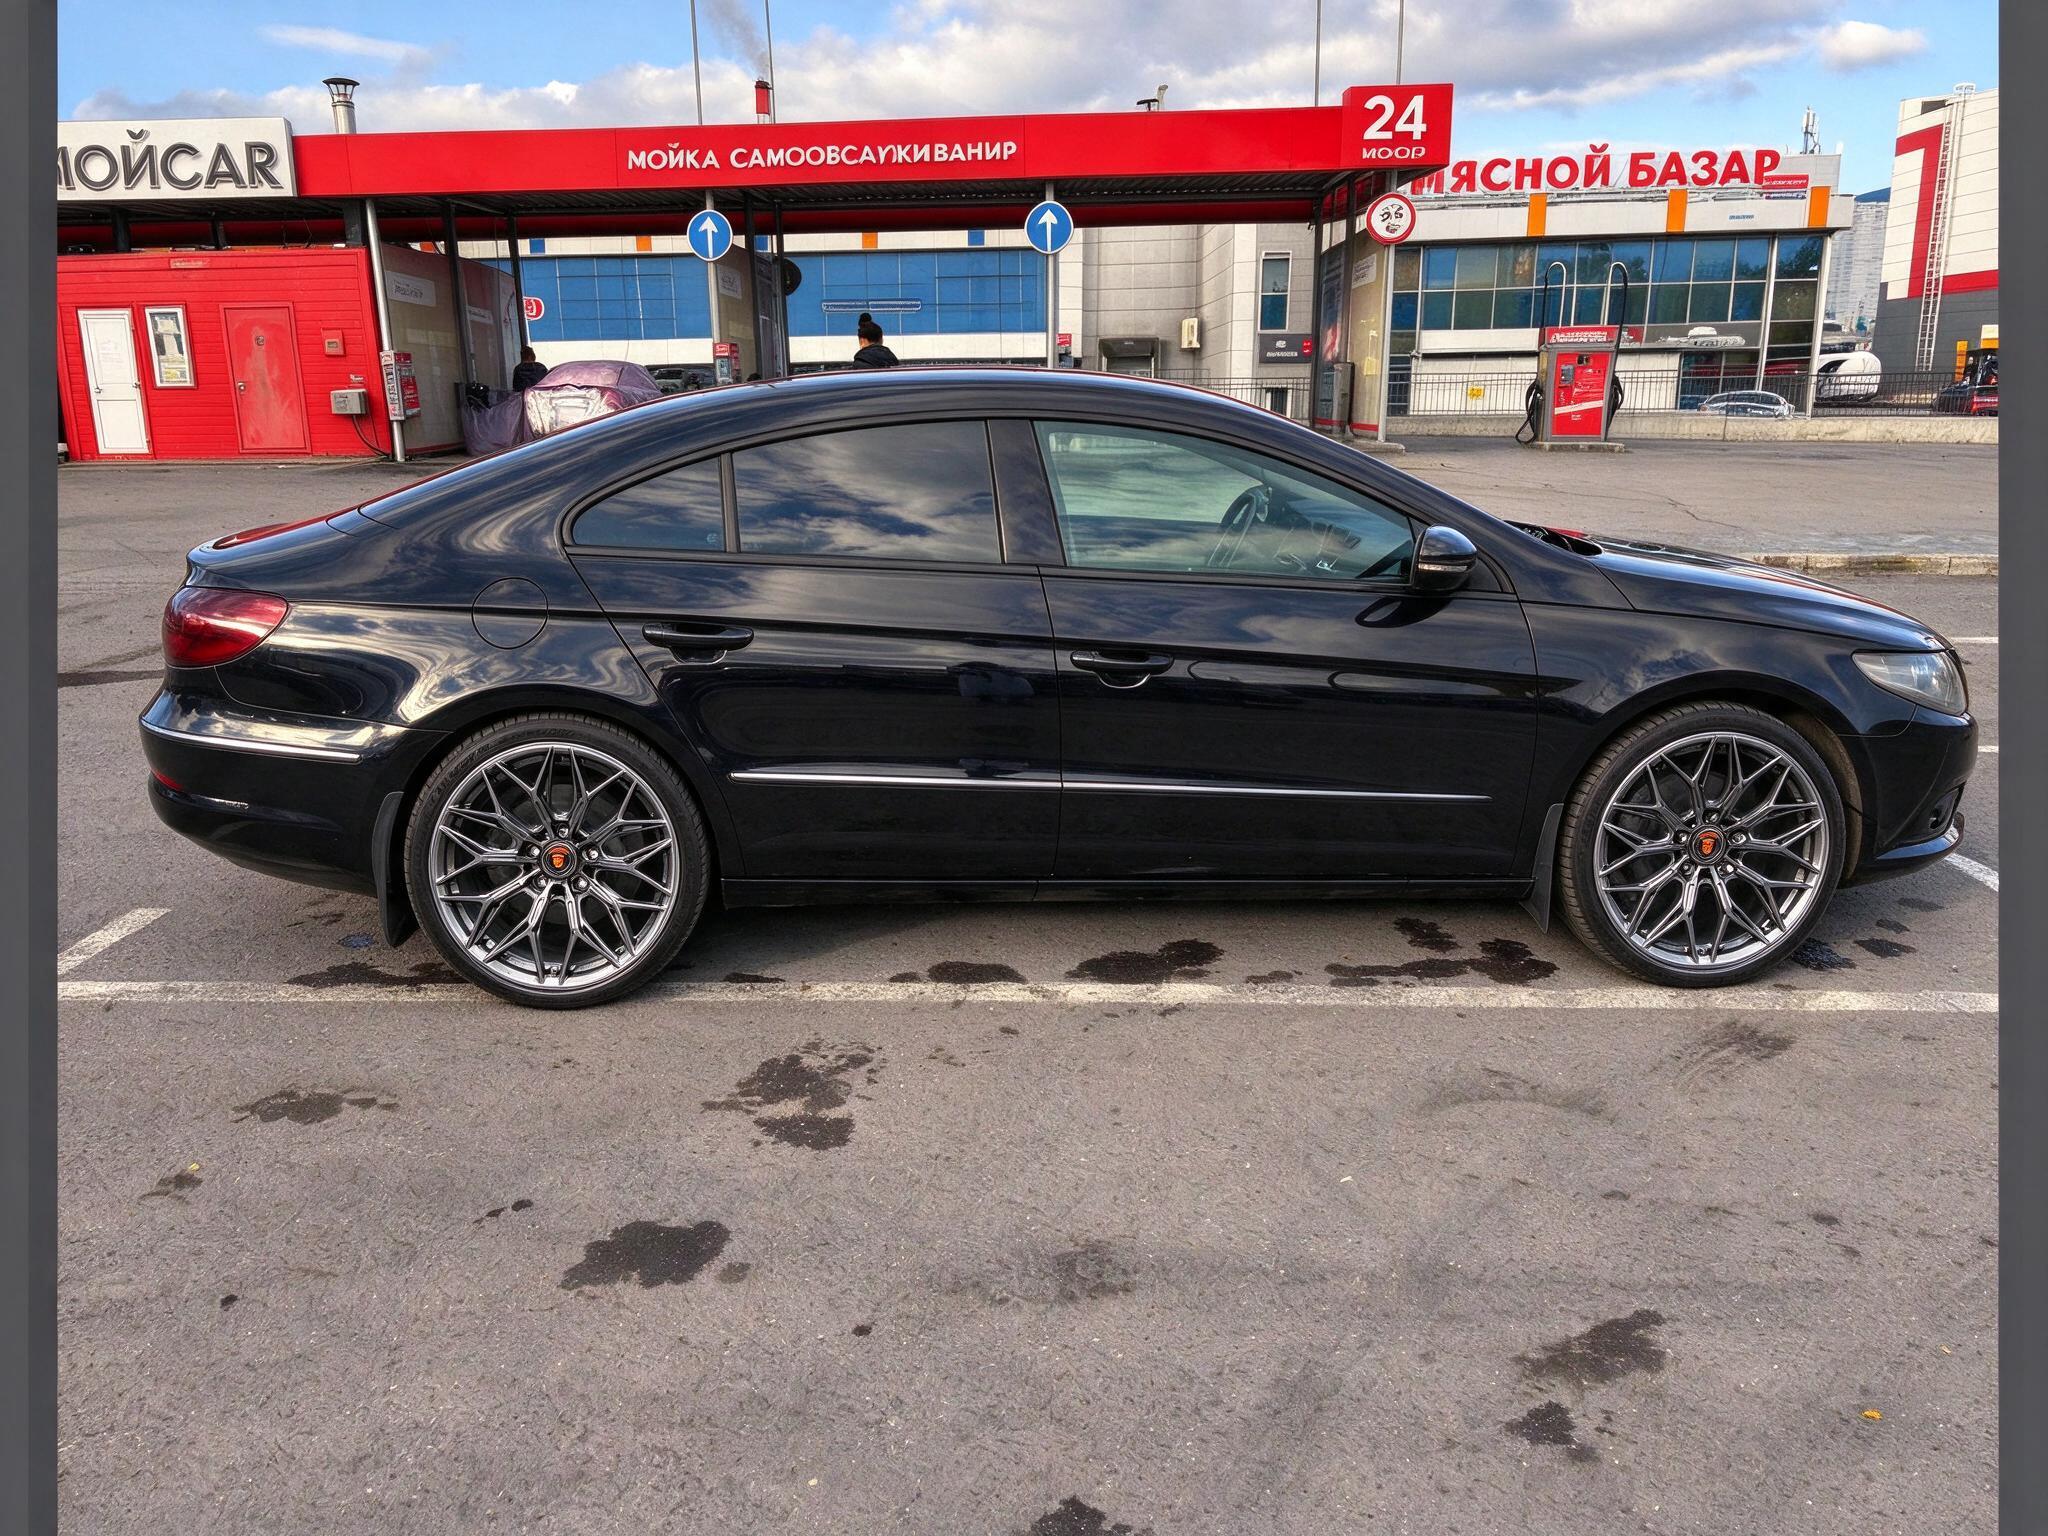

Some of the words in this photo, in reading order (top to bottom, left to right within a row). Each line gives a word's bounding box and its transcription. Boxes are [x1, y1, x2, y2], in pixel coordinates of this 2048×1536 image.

[1363, 94, 1427, 140] 24
[627, 142, 720, 170] МОЙКА
[1628, 149, 1781, 188] БАЗАР
